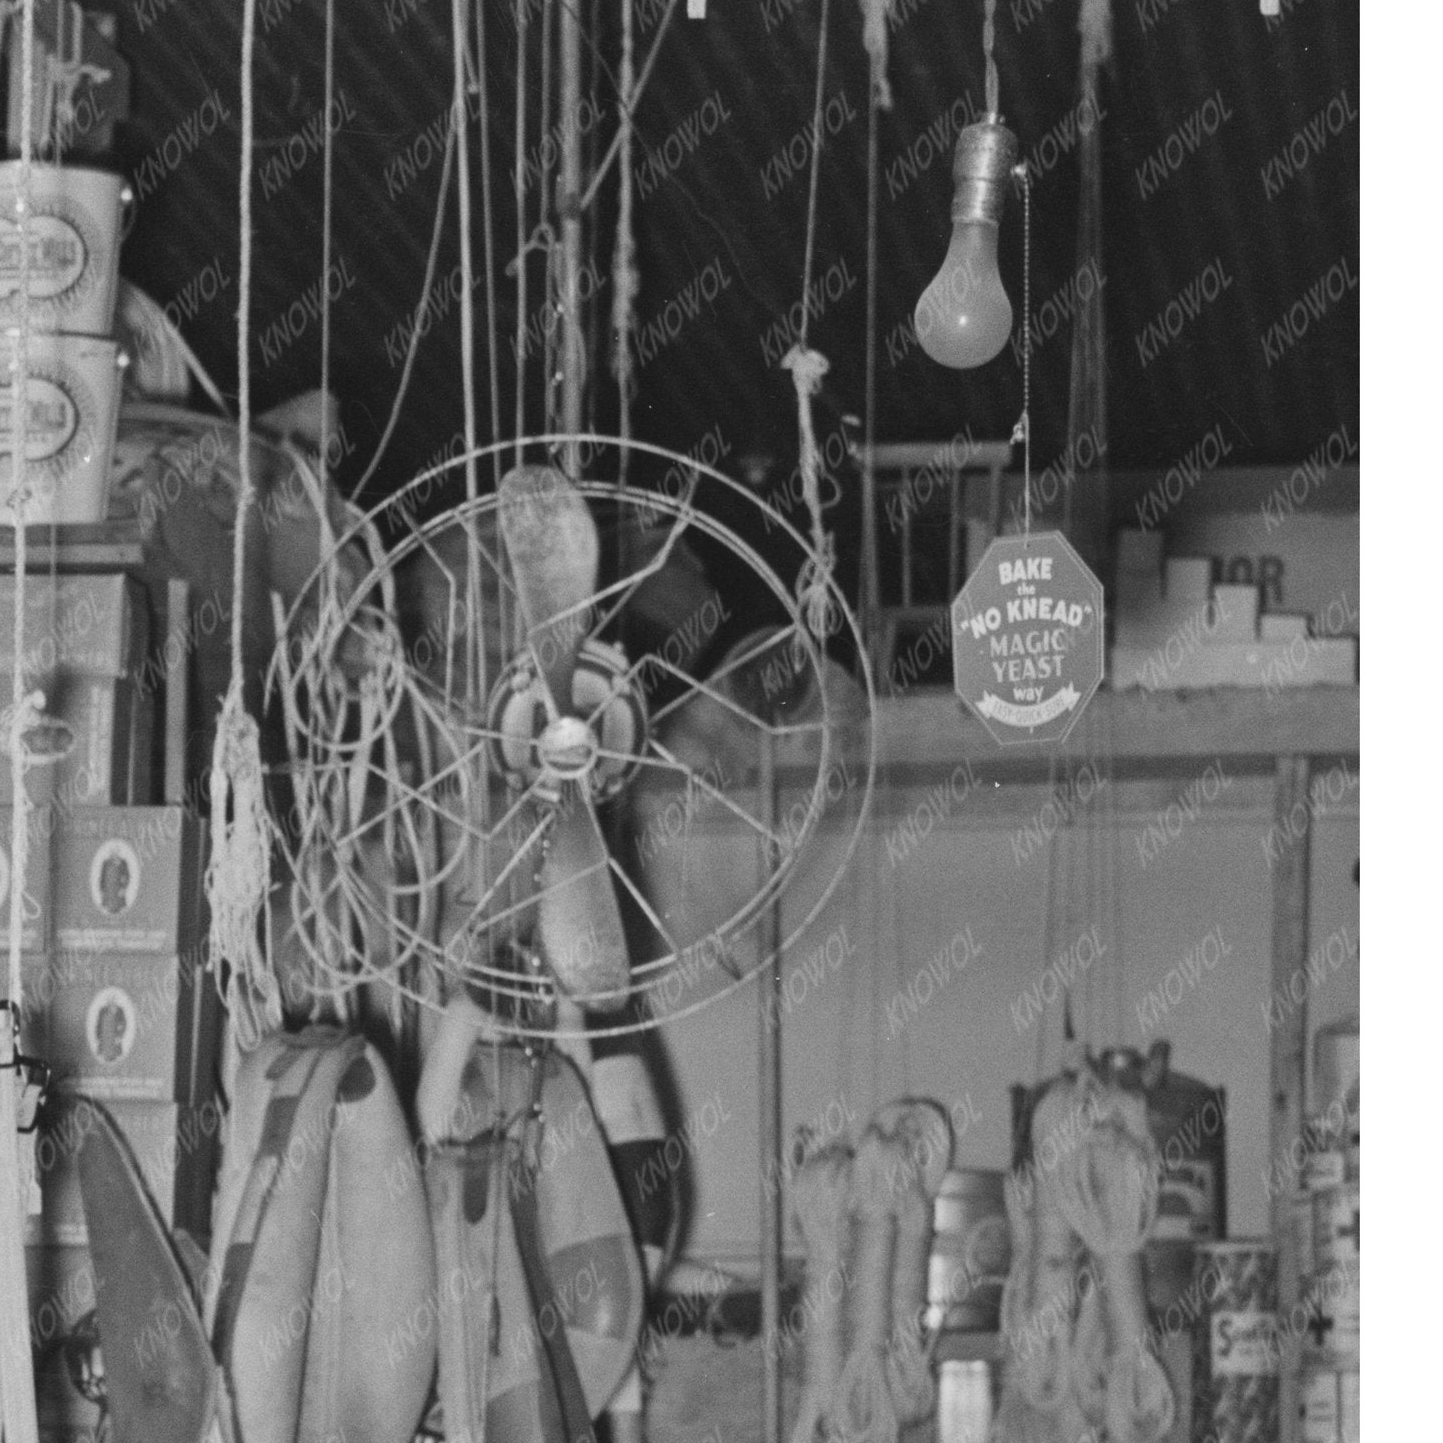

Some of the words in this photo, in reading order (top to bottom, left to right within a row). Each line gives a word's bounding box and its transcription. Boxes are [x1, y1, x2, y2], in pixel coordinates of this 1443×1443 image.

[998, 557, 1053, 585] BAKE
[1017, 582, 1036, 596] the
[989, 627, 1067, 658] MAGIC
[992, 655, 1065, 684] YEAST
[1013, 684, 1045, 704] way
